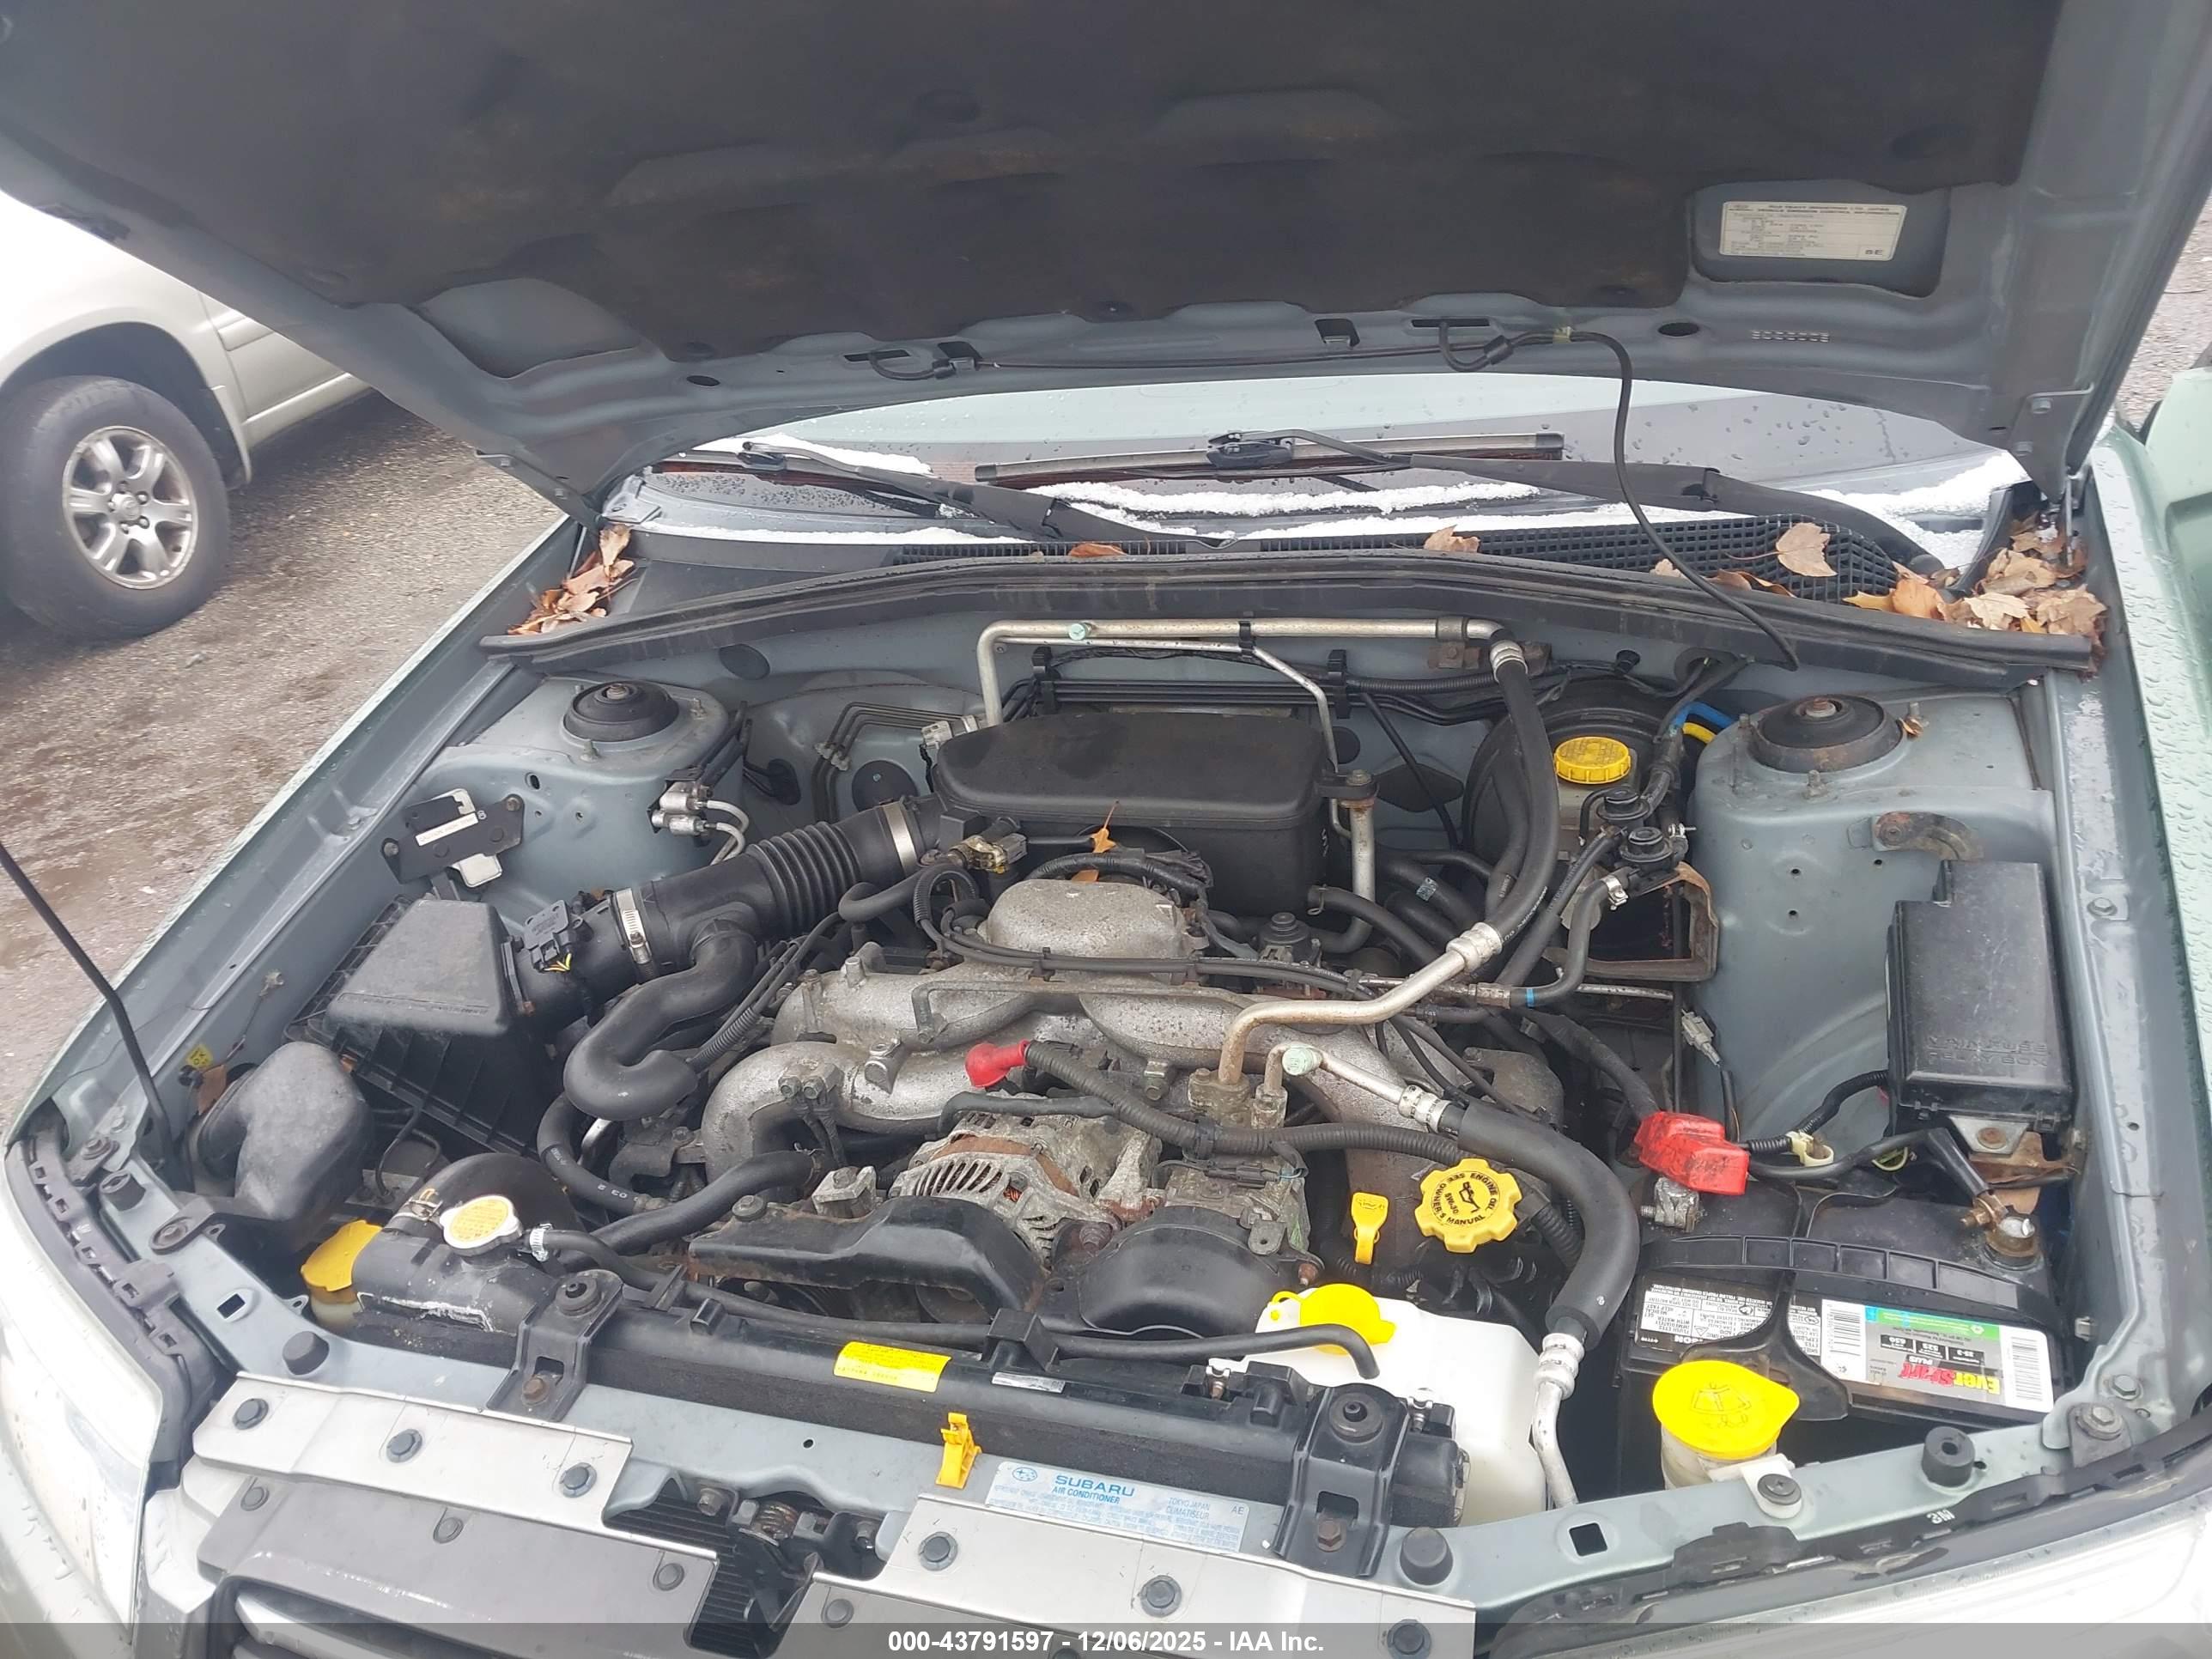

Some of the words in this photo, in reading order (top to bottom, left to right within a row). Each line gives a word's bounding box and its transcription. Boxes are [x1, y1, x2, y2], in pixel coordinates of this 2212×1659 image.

[1446, 1172, 1467, 1183] SEE
[1469, 1172, 1498, 1196] ENGINE
[1485, 1198, 1498, 1212] OIL
[1446, 1213, 1486, 1225] MANUAL
[1908, 1355, 1933, 1365] PLUS
[1899, 1363, 2000, 1395] EverStart
[1054, 1474, 1135, 1497] SUBARU
[1051, 1486, 1066, 1495] AIR
[1066, 1487, 1121, 1504] CONDITIONER
[1231, 1504, 1245, 1516] AE
